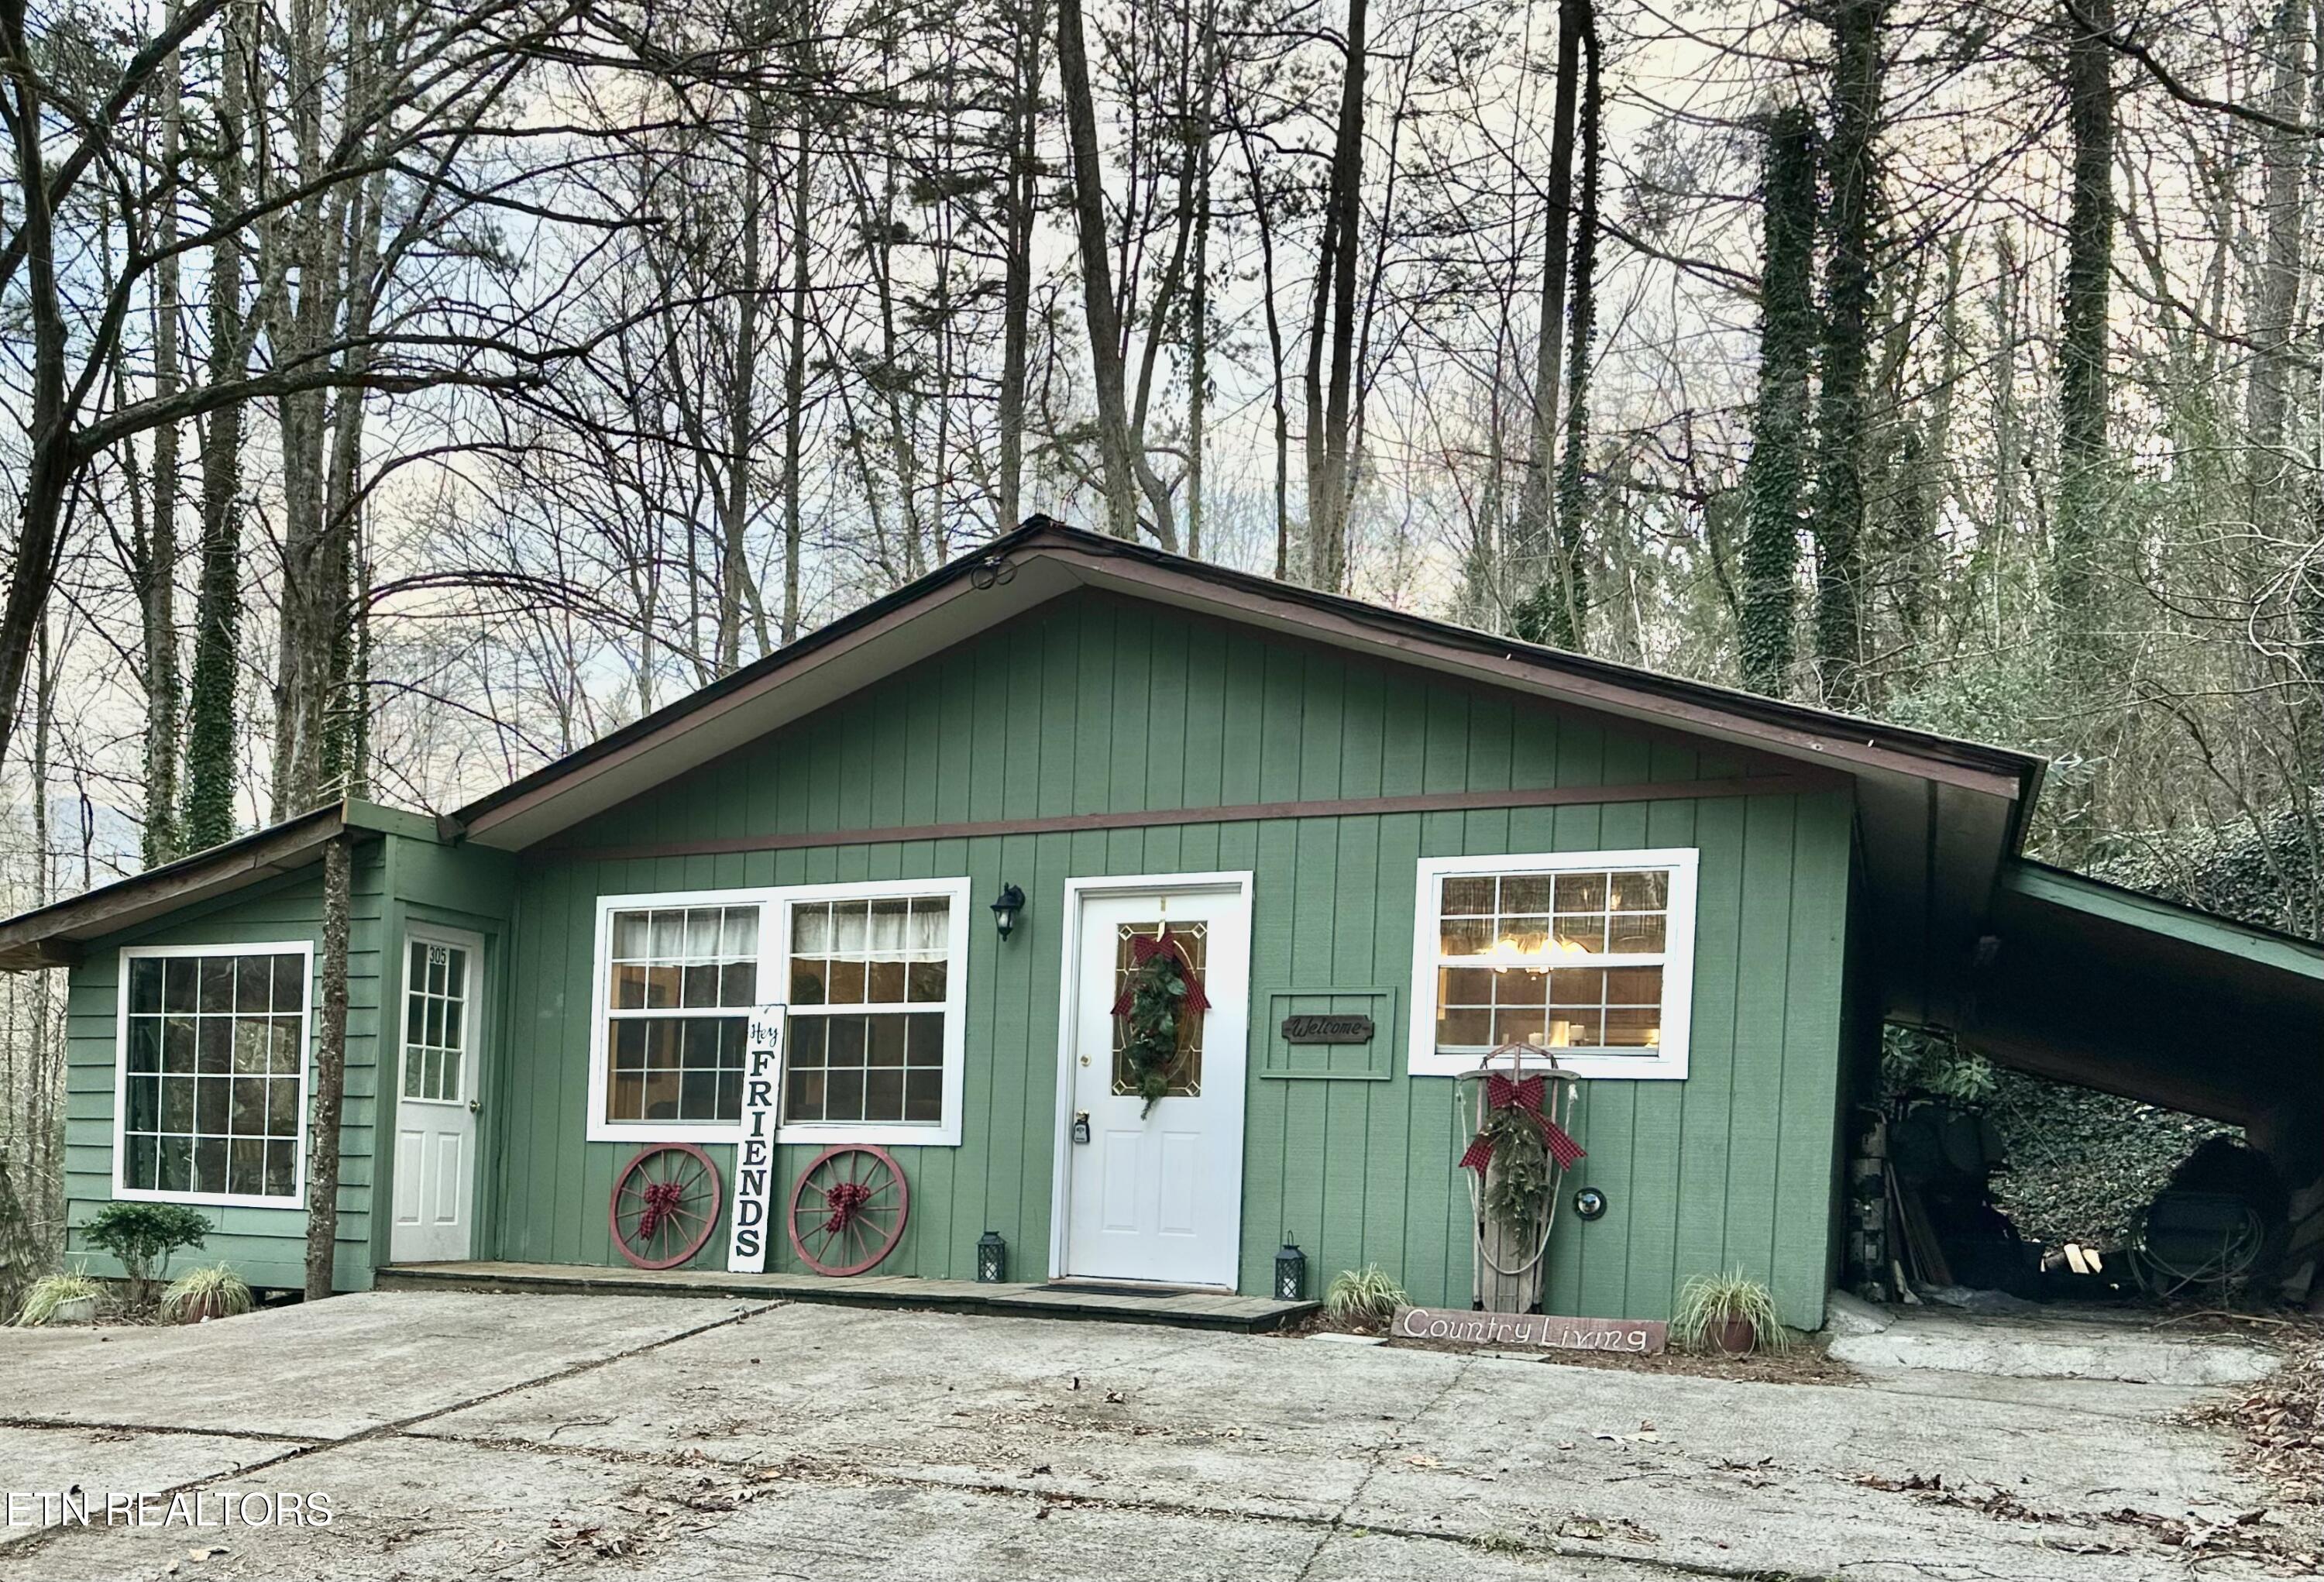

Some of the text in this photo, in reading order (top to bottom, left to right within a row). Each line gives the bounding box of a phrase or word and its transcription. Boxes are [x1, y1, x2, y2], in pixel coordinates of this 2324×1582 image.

[429, 947, 446, 964] 305
[749, 1021, 779, 1047] Hey
[1291, 1016, 1362, 1037] Welcome
[736, 1051, 775, 1257] FRIENDS
[1404, 1309, 1647, 1352] Country Living
